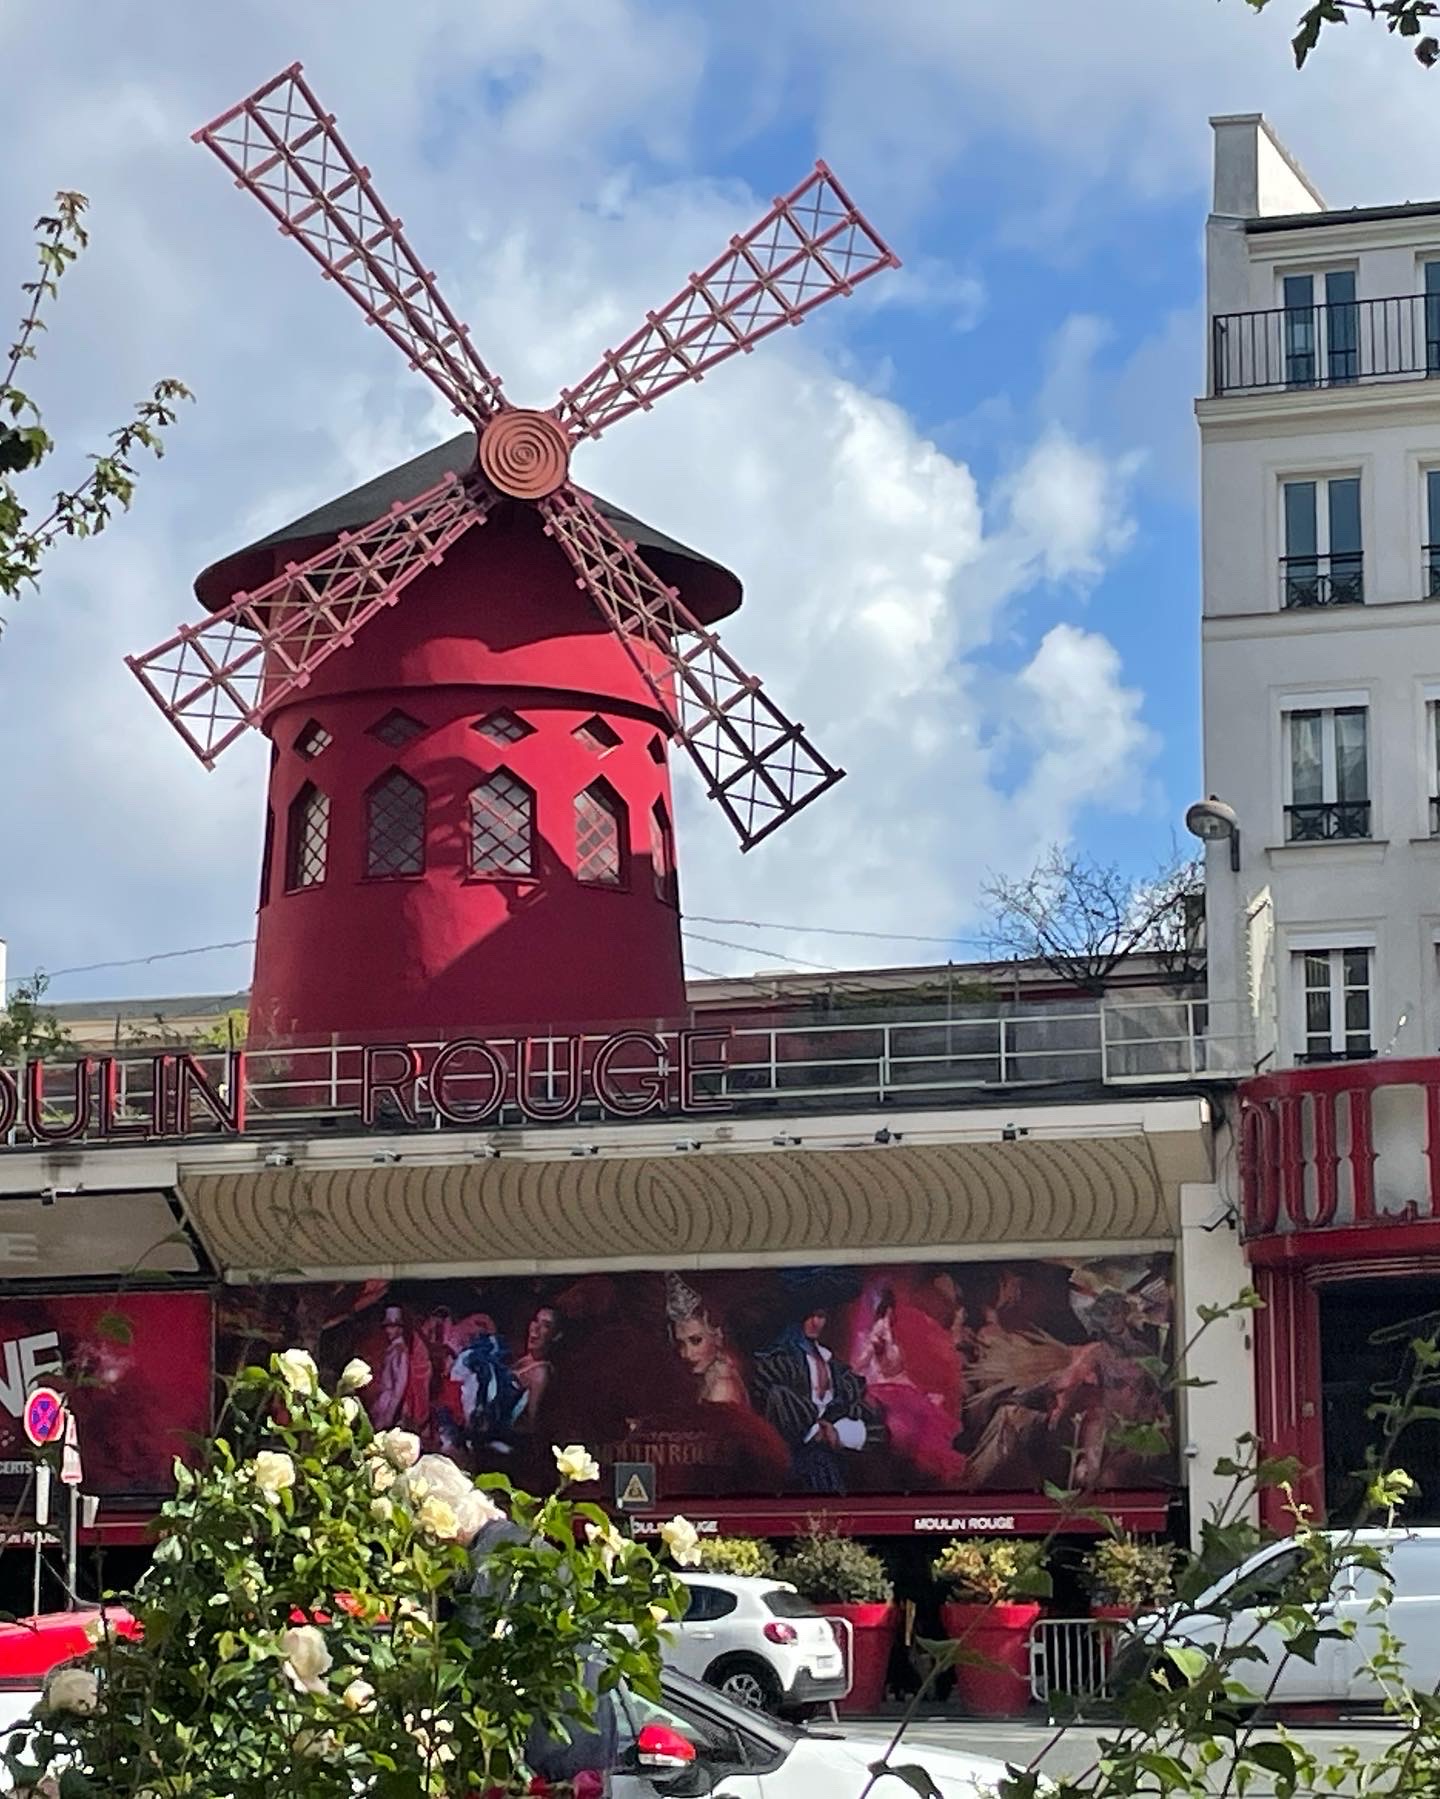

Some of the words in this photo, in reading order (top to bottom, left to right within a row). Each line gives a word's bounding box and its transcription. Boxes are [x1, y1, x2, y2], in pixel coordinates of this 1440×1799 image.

[0, 1050, 247, 1144] ULIN
[360, 1025, 735, 1126] ROUGE
[914, 1517, 966, 1531] MOULIN
[968, 1516, 1015, 1530] ROUGE
